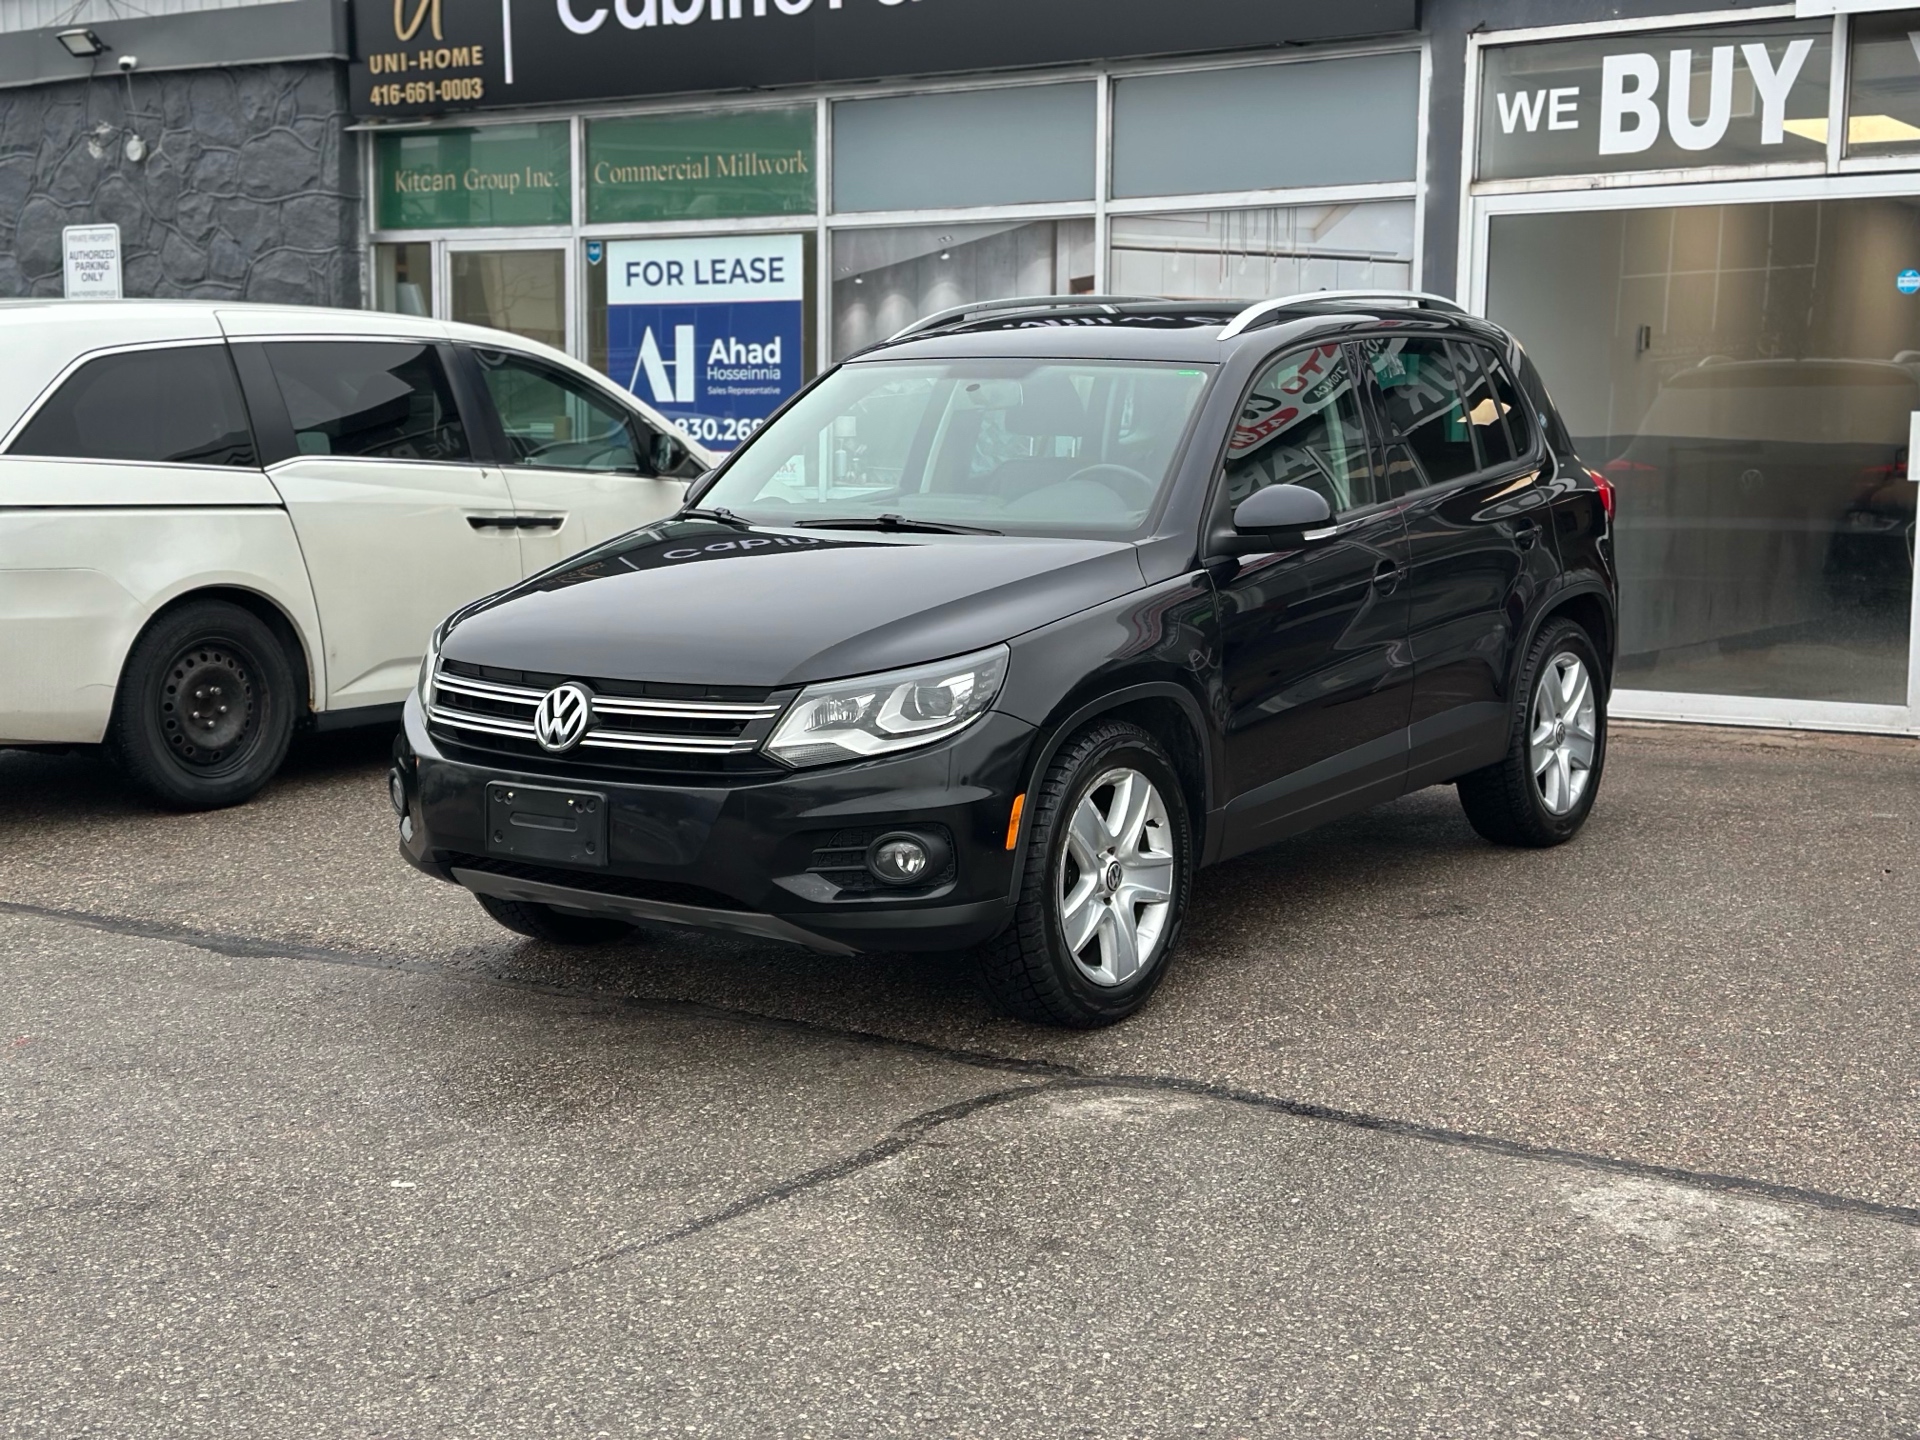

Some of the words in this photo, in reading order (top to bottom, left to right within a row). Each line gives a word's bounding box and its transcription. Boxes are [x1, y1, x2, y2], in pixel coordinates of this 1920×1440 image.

[369, 45, 484, 74] UNI-HOME
[370, 77, 484, 106] 416-661-0003
[1497, 86, 1580, 134] WE
[1598, 38, 1815, 155] BUY
[394, 169, 457, 193] Kitcan
[463, 167, 520, 195] Group
[525, 165, 560, 189] Inc.
[593, 155, 710, 185] Commercial
[716, 149, 809, 178] Millwork
[69, 249, 115, 260] AUTHORIZED
[75, 261, 110, 271] PARKING
[81, 272, 104, 283] ONLY
[625, 260, 684, 287] FOR
[693, 256, 785, 285] LEASE
[707, 336, 782, 365] Ahad
[706, 366, 782, 381] Hosseinnia
[706, 385, 727, 396] Sales
[727, 385, 782, 397] Representative
